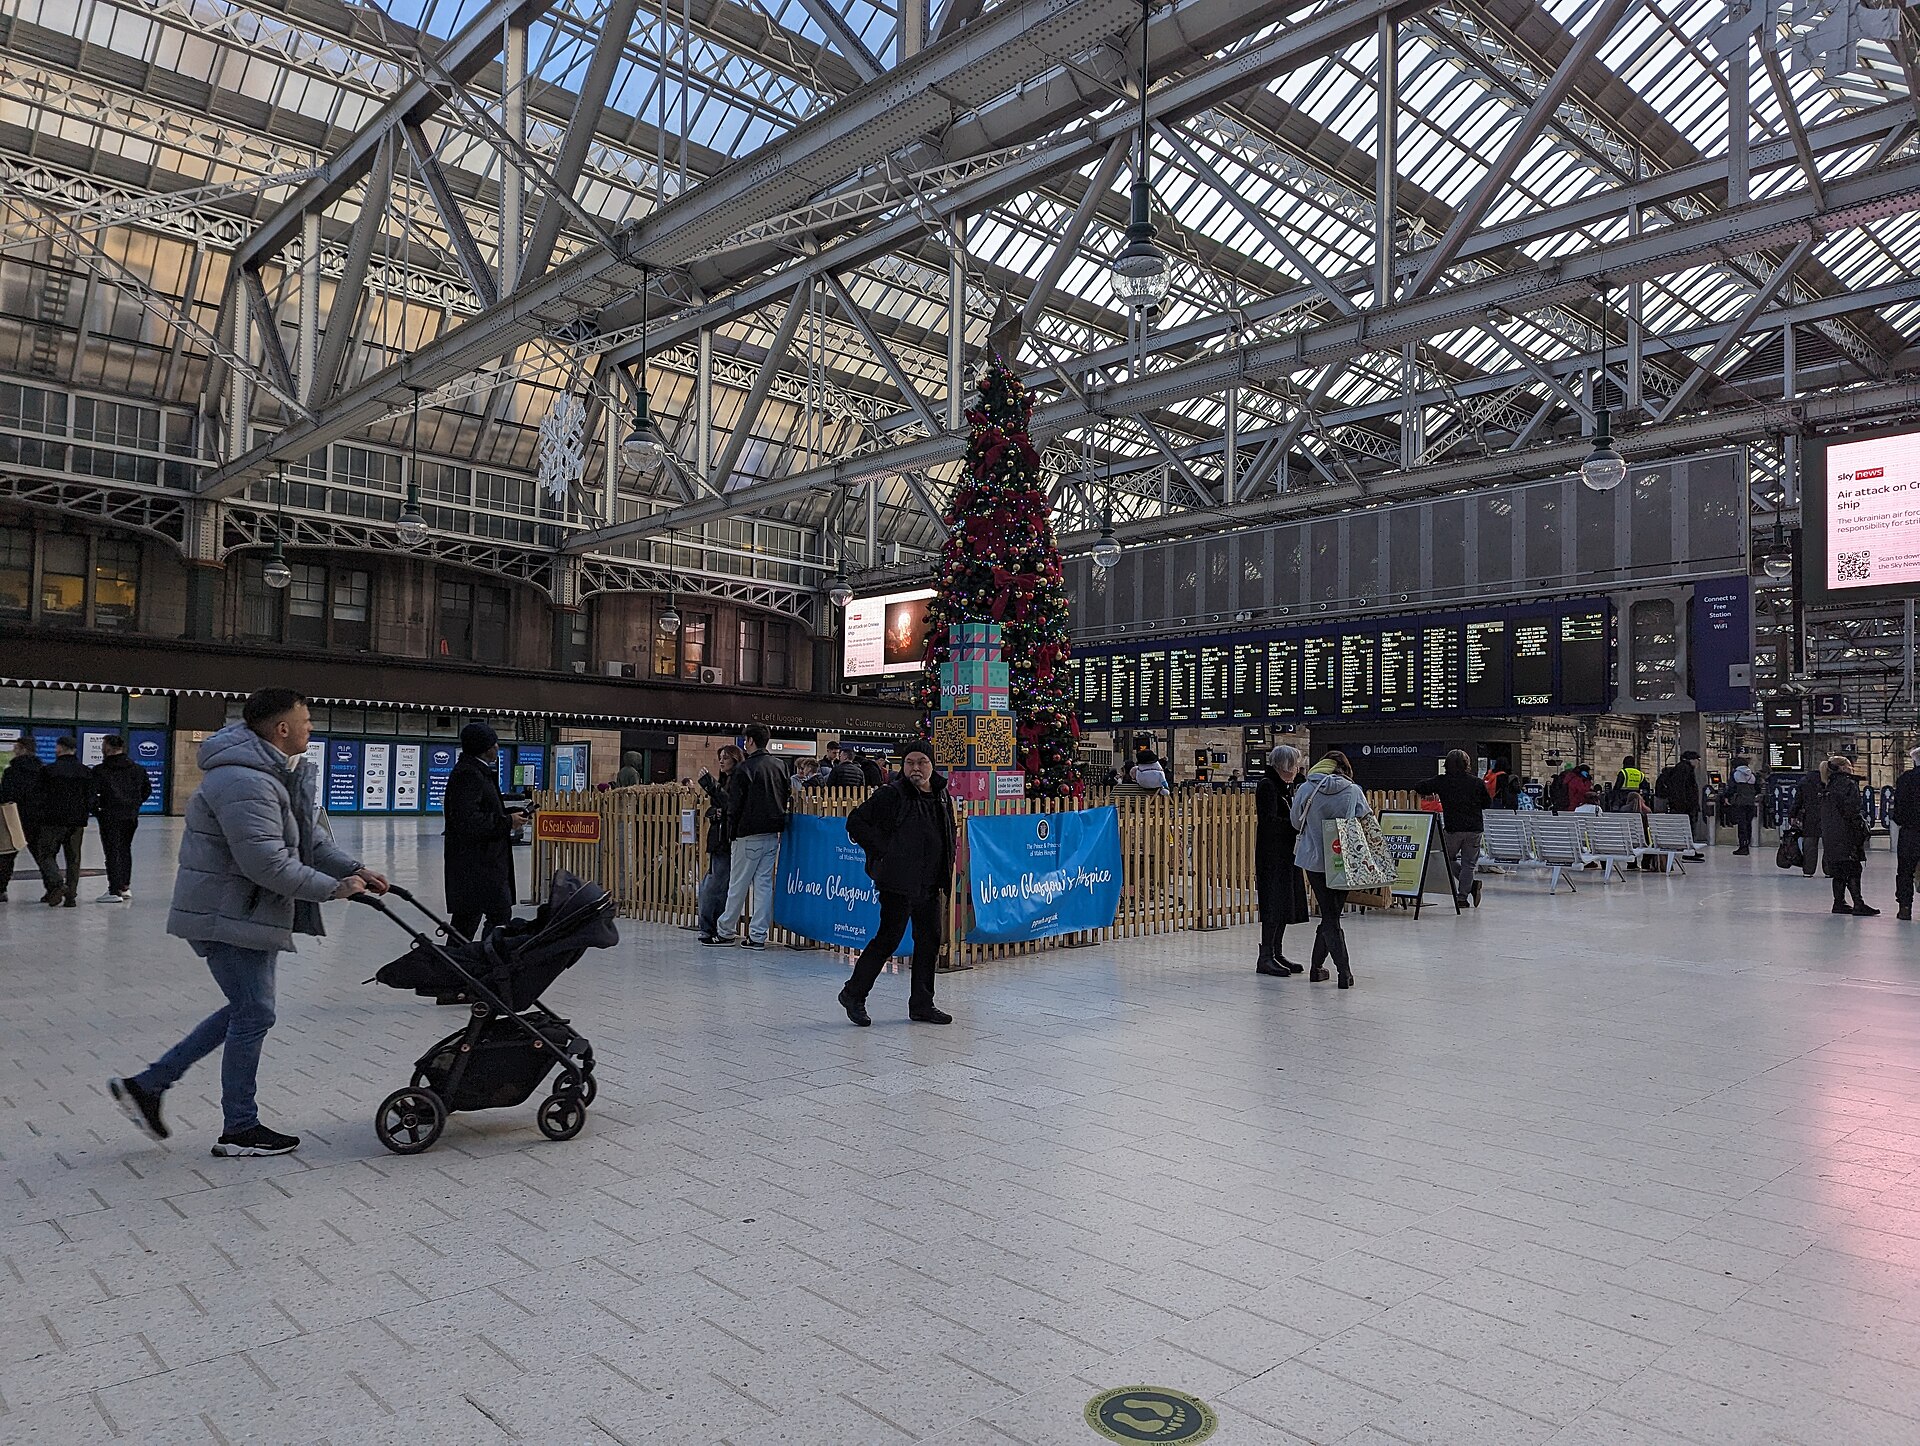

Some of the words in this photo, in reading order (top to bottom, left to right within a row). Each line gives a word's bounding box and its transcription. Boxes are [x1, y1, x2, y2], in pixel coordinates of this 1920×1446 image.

[1838, 473, 1853, 481] sky
[1856, 469, 1882, 479] news
[1838, 490, 1852, 499] Air
[1855, 486, 1890, 497] attack
[1838, 501, 1860, 510] ship
[1854, 513, 1891, 523] Ukrainian
[1838, 522, 1890, 533] responsibility
[942, 684, 970, 696] MORE
[1517, 696, 1549, 705] 14:25:06
[1822, 698, 1834, 712] 5
[776, 714, 802, 723] luggage
[854, 719, 885, 728] Customer
[886, 721, 906, 730] lounge
[1374, 744, 1417, 754] Information
[542, 820, 548, 832] G
[549, 820, 566, 833] Scale
[566, 820, 594, 834] Scotland
[787, 868, 804, 895] We
[805, 882, 822, 895] are
[826, 875, 880, 911] Glasgow's
[980, 873, 998, 905] We
[1000, 885, 1018, 899] are
[1021, 868, 1075, 905] Glasgow's
[1075, 865, 1112, 894] Hospice
[1031, 913, 1058, 928] ppwh.org.uk
[834, 923, 866, 936] ppwh.org.uk
